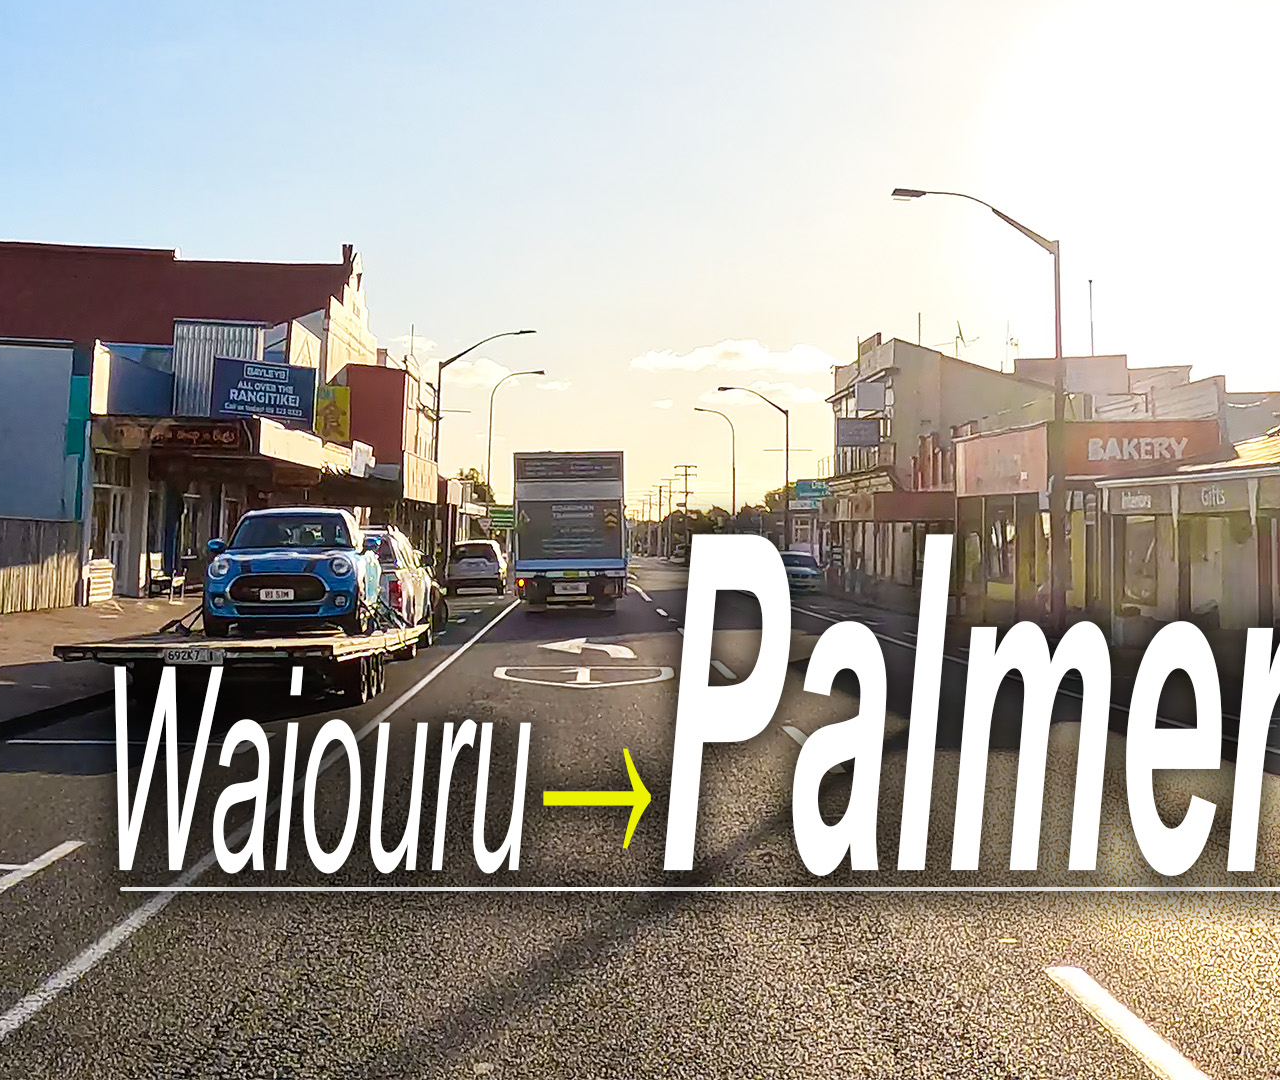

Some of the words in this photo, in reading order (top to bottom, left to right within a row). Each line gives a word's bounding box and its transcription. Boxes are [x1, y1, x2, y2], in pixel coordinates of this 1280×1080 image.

[229, 388, 300, 407] RANGITIKEI
[237, 380, 253, 390] ALL
[255, 382, 277, 393] OVER
[278, 384, 295, 395] THE
[1088, 436, 1188, 462] BAKERY
[1200, 485, 1226, 508] Gifts
